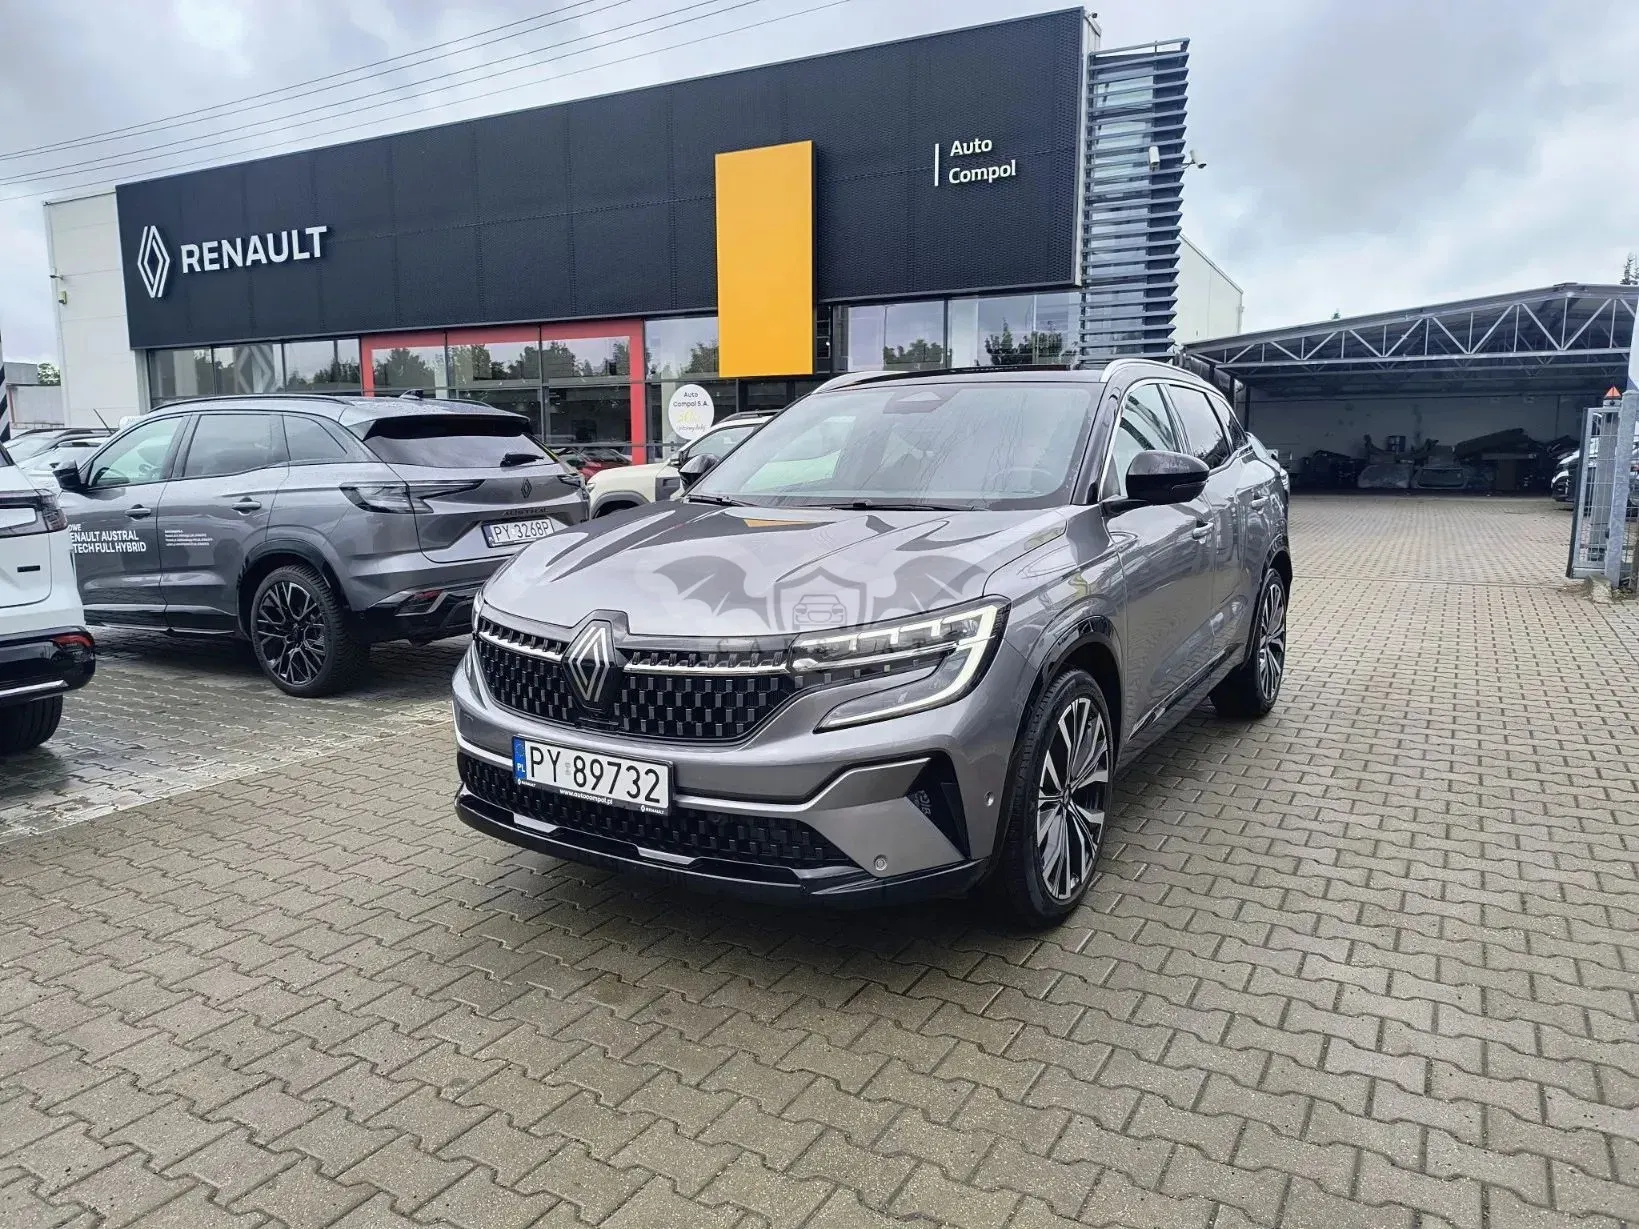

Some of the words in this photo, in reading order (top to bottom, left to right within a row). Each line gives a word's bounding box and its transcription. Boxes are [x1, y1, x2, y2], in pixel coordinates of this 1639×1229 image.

[949, 138, 993, 157] Auto
[948, 159, 1017, 184] Compol
[180, 225, 328, 274] RENAULT
[683, 391, 699, 399] Auto
[673, 400, 697, 408] Compol
[67, 523, 82, 532] OWE
[493, 524, 511, 541] PY
[513, 520, 549, 538] 3268P
[70, 530, 100, 543] ENAULT
[101, 529, 139, 542] AUSTRAL
[72, 543, 95, 554] TECH
[95, 542, 115, 553] FULL
[115, 541, 147, 553] HYBRID
[516, 762, 526, 773] PL
[529, 745, 561, 783] PY
[573, 755, 661, 804] 89732
[559, 788, 613, 805] www.autocompol.pl
